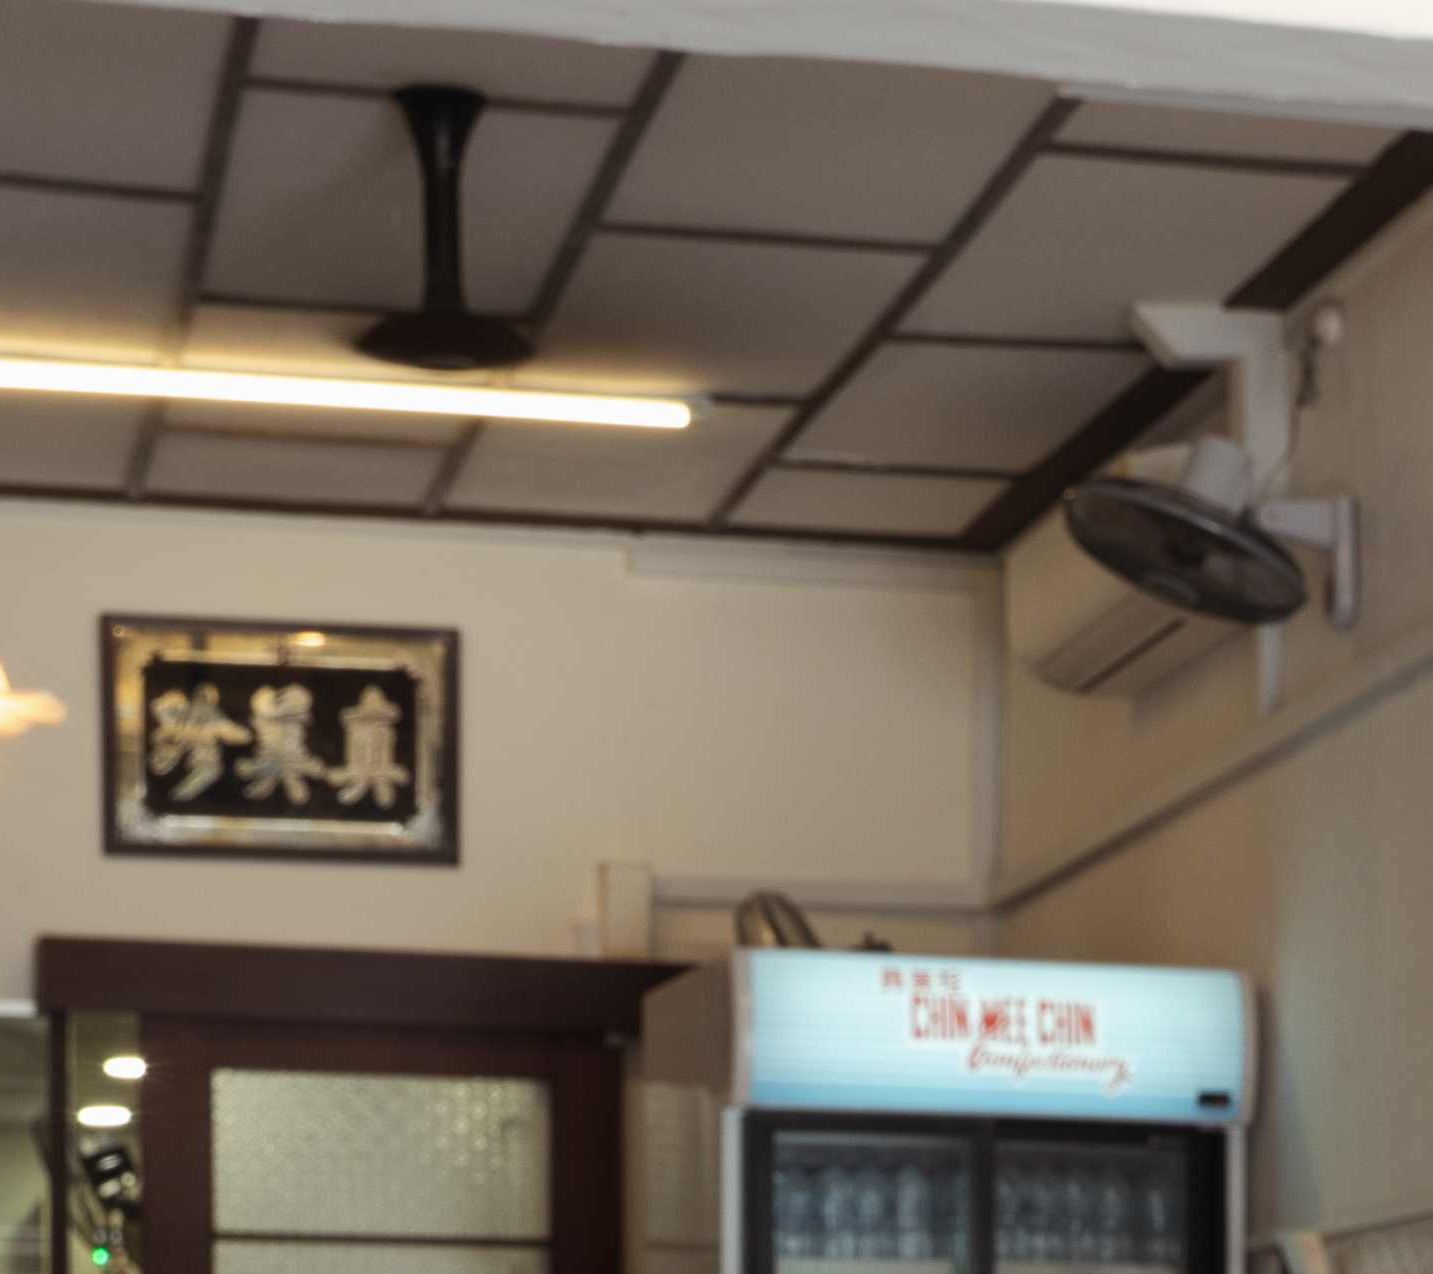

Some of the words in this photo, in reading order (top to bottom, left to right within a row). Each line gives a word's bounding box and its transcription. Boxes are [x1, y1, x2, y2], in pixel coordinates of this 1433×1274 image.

[912, 995, 969, 1040] CHIN
[979, 998, 1028, 1045] MEE
[1038, 1000, 1096, 1045] CHIN
